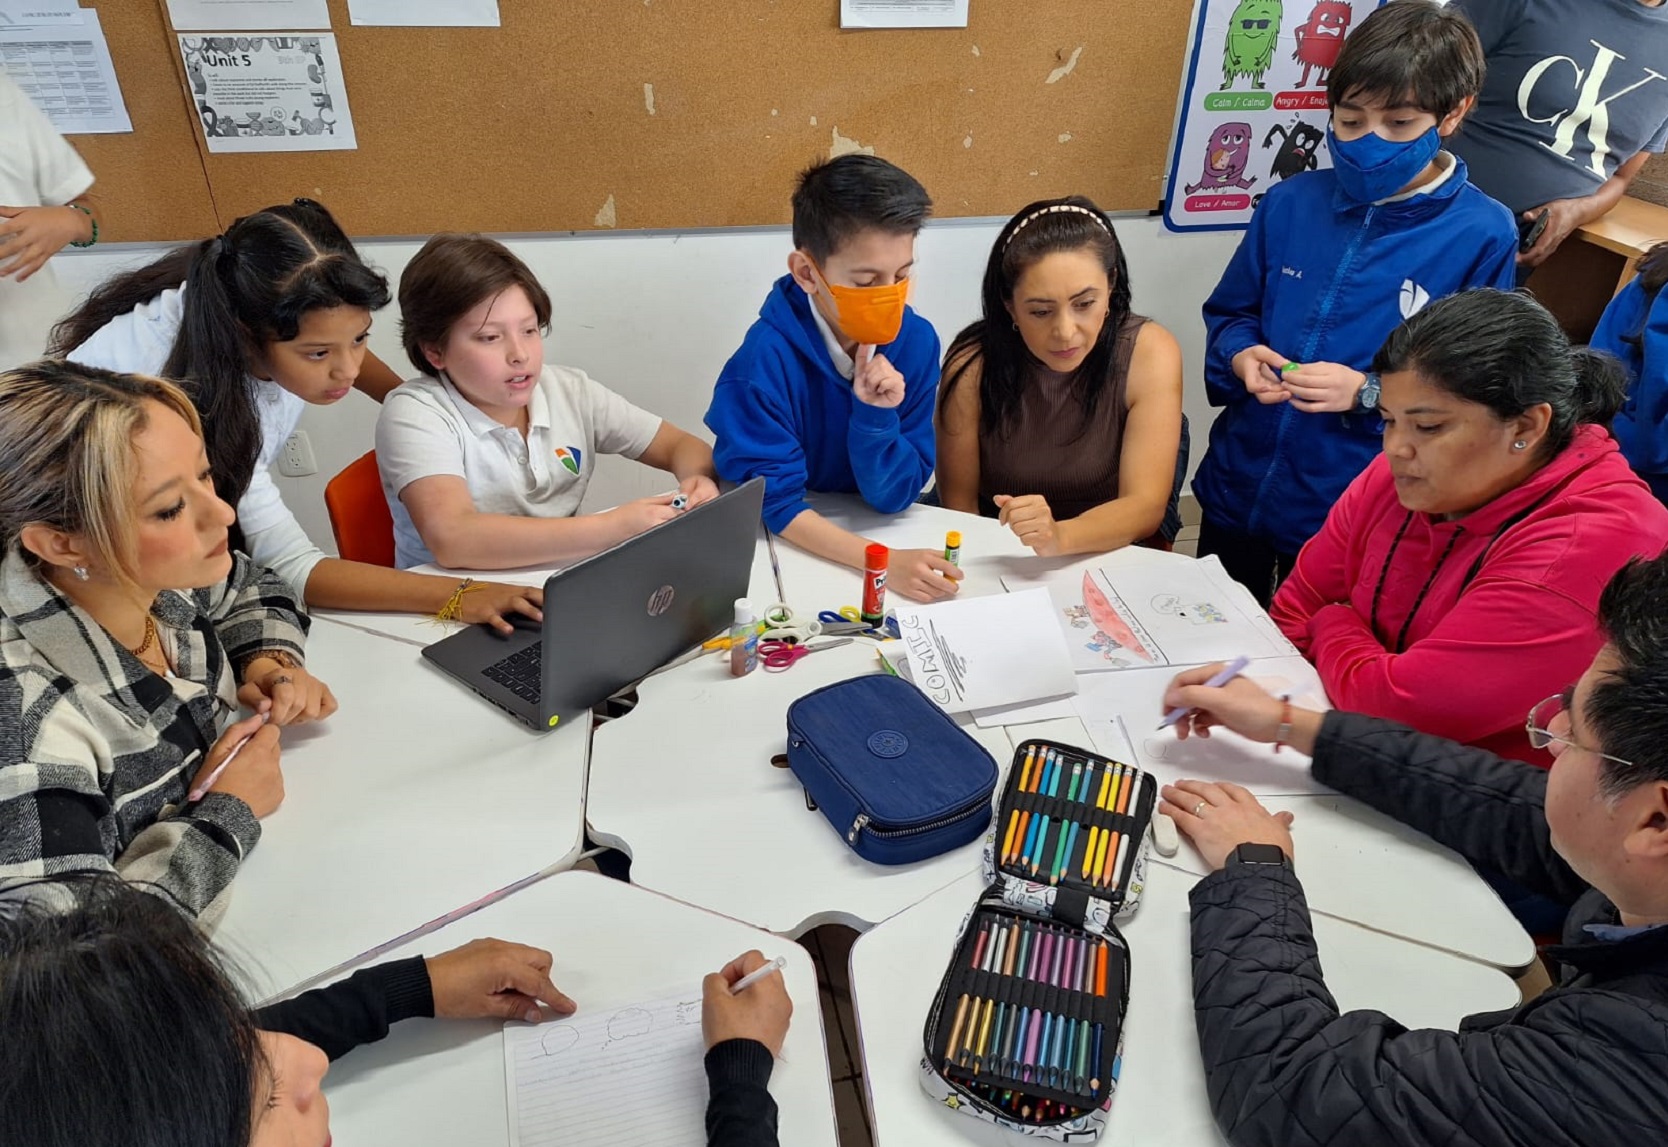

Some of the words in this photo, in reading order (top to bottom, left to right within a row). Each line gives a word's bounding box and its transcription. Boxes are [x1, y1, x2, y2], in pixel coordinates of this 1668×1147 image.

[207, 54, 239, 67] Unit
[242, 54, 252, 67] 5
[1212, 98, 1232, 108] Calm
[1242, 97, 1265, 107] Calma
[1276, 96, 1299, 107] Angry
[1517, 39, 1667, 181] CK
[1194, 200, 1211, 208] Love
[1221, 199, 1240, 207] Amor
[647, 585, 675, 617] hp
[902, 615, 951, 705] COMIC
